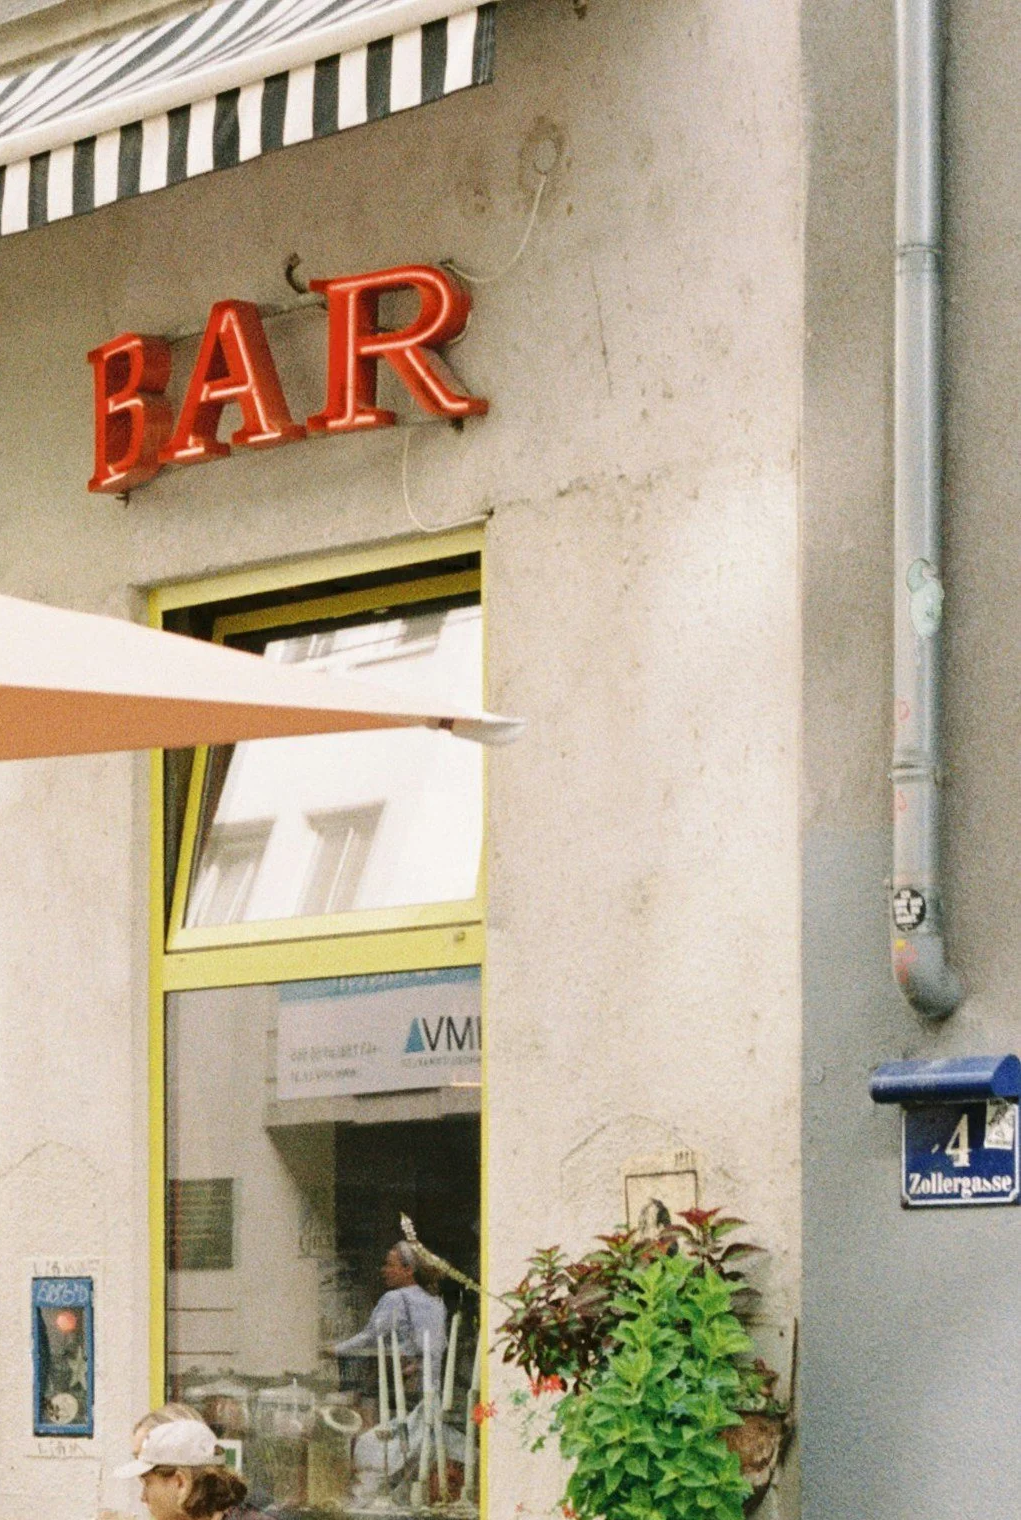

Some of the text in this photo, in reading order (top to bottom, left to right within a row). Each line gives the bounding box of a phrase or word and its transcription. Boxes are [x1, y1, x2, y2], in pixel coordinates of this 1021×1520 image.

[88, 264, 489, 492] BAR
[945, 1113, 972, 1167] 4
[909, 1172, 1012, 1198] Zollergasse
